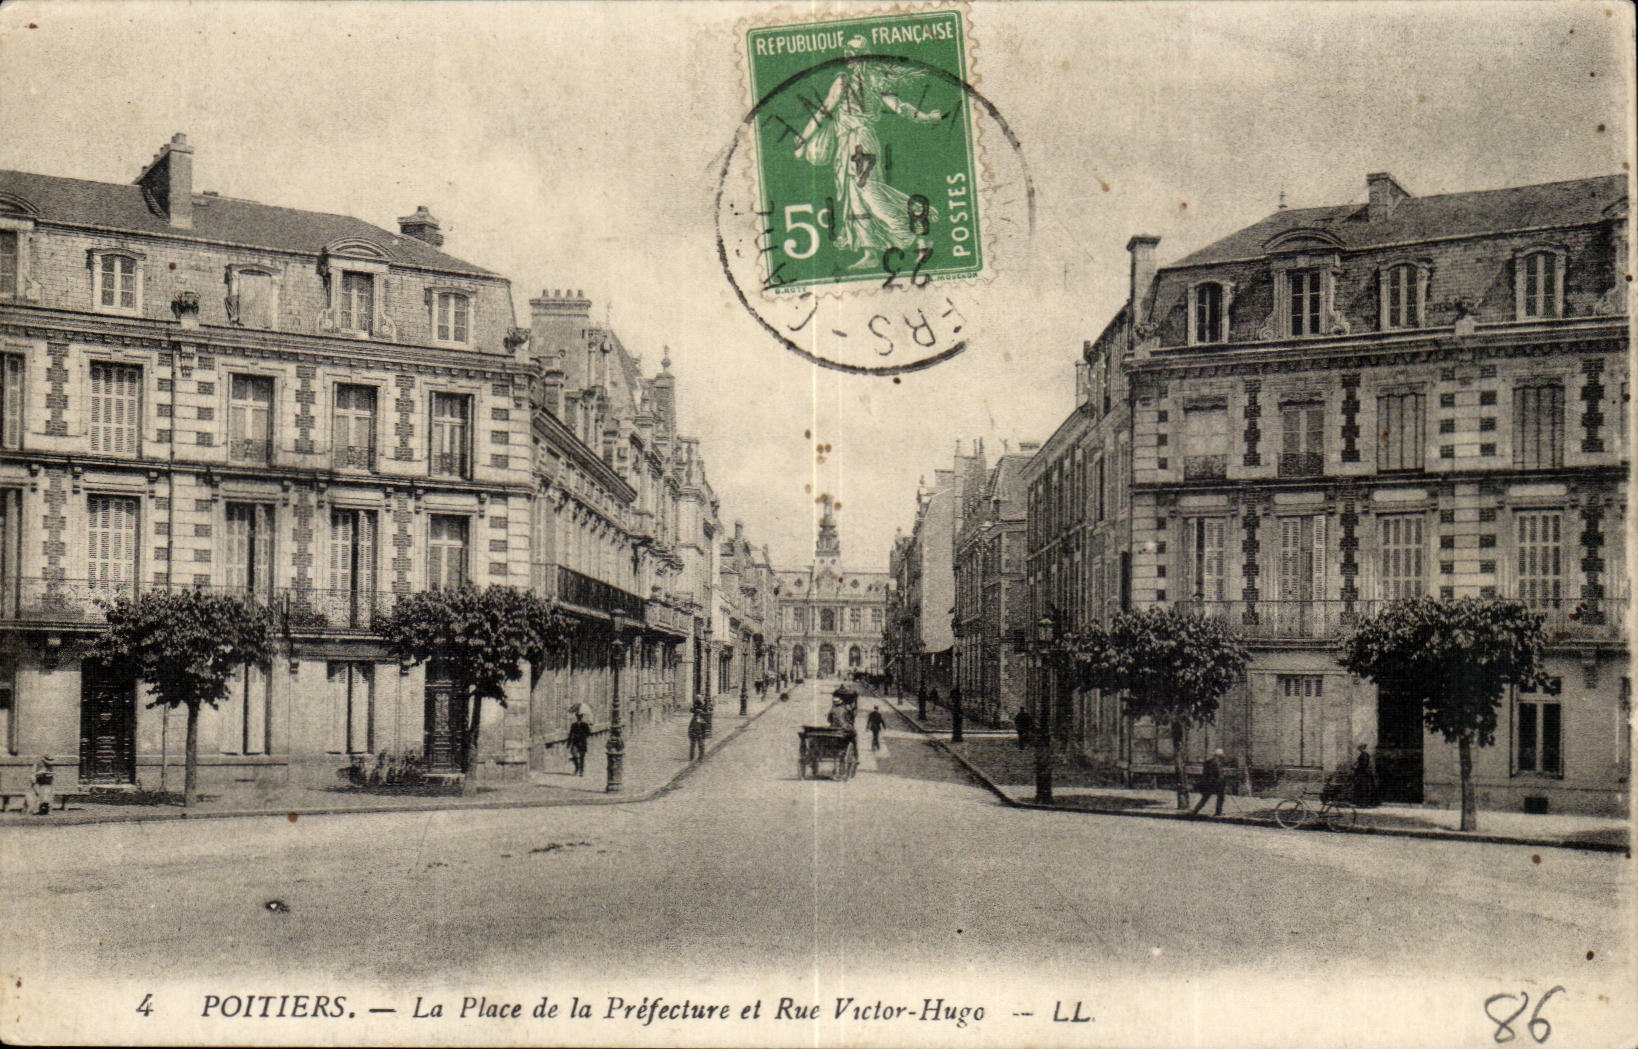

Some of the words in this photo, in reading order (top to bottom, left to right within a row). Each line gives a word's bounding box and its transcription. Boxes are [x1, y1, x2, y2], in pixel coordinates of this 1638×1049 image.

[871, 21, 954, 45] FRANÇAISE
[946, 172, 971, 257] POSTES
[1484, 985, 1566, 1044] 86
